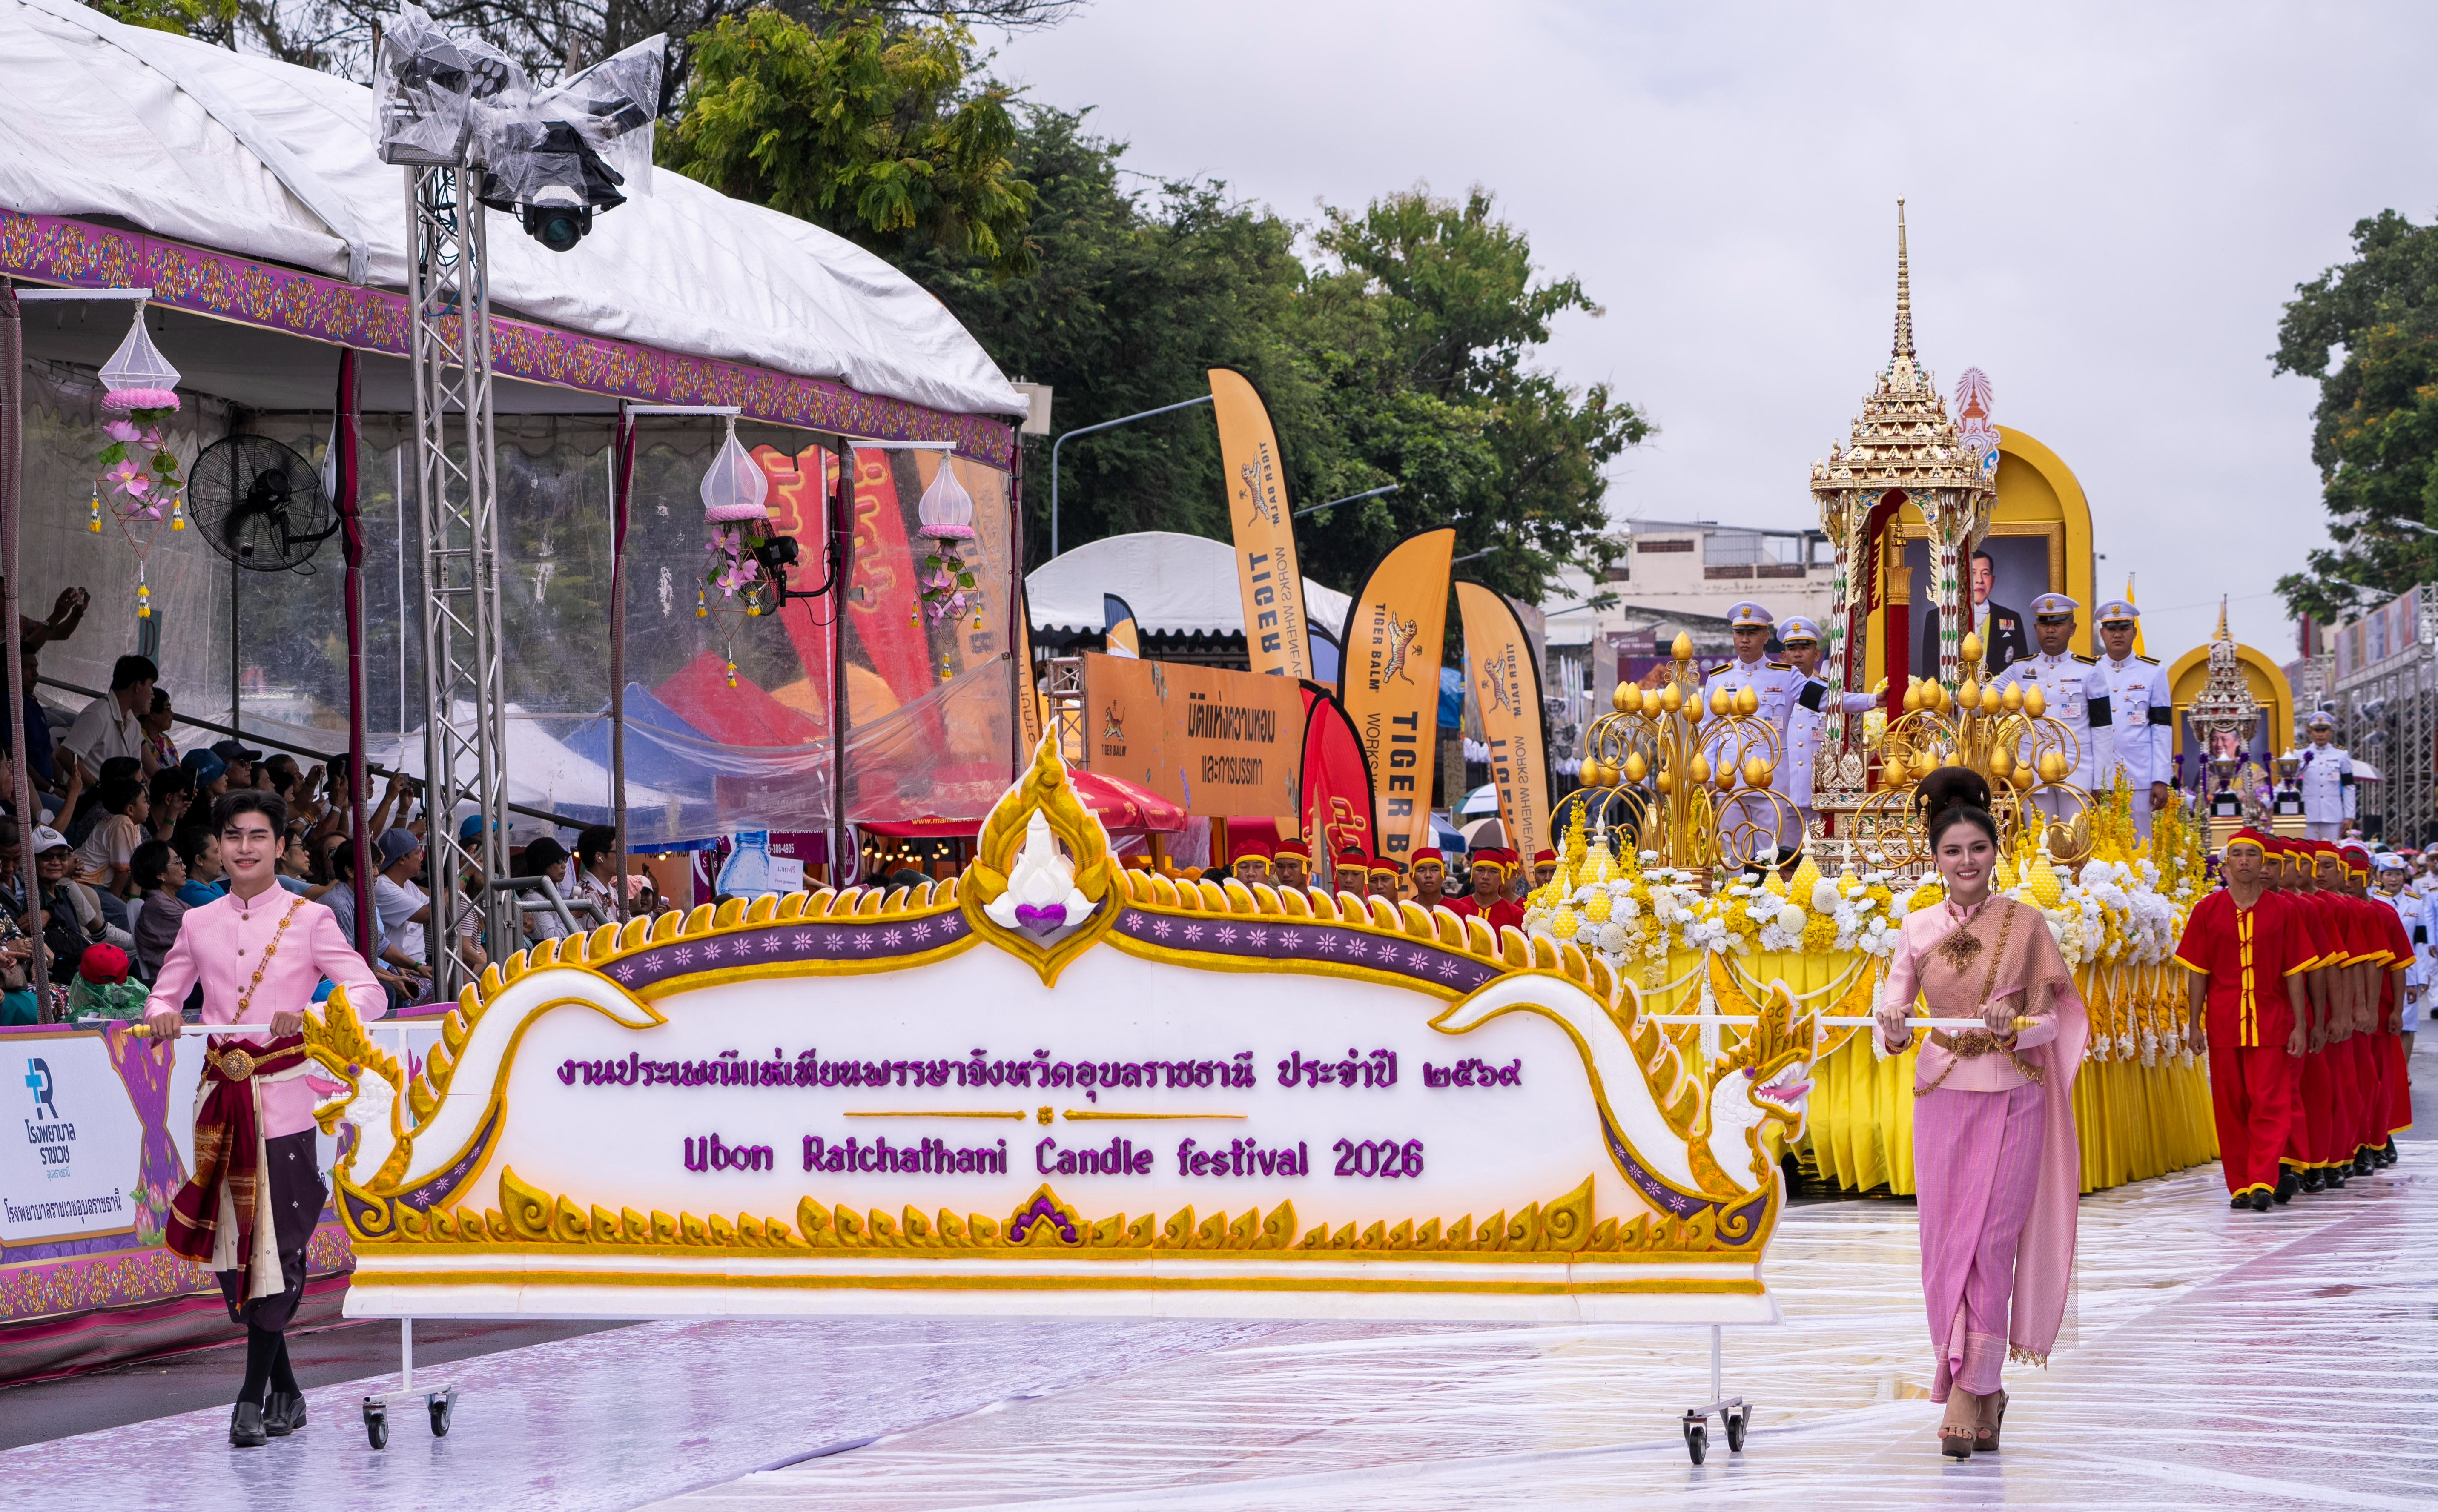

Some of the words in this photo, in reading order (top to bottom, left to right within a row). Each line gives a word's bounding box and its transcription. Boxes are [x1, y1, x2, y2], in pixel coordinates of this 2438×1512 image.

[142, 619, 156, 657] D
[1372, 603, 1386, 645] TIGER
[1188, 690, 1276, 743] มิติแห่งความหอม
[1101, 744, 1112, 756] TIGER
[1113, 745, 1127, 757] BALM
[1388, 711, 1418, 817] TIGER
[1202, 755, 1263, 785] และการบรรเทา
[777, 865, 795, 873] แจกฟรี
[557, 1047, 1257, 1103] งานประเพณีแห่เทียนพรรษาจังหวัดอุบลราชธานี
[1277, 1048, 1398, 1089] ประจำปี
[1422, 1058, 1522, 1088] ๒๕๖๙
[24, 1119, 76, 1144] โรงพยาบาล
[40, 1145, 70, 1165] ราชเวช
[684, 1132, 774, 1173] Ubon
[802, 1135, 1007, 1174] Ratchathani
[1035, 1136, 1154, 1175] Candle
[1176, 1137, 1309, 1177] festival
[1332, 1138, 1424, 1178] 2026
[4, 1187, 122, 1224] โรงพยาบาลราชเวชอุบลราชธานี
